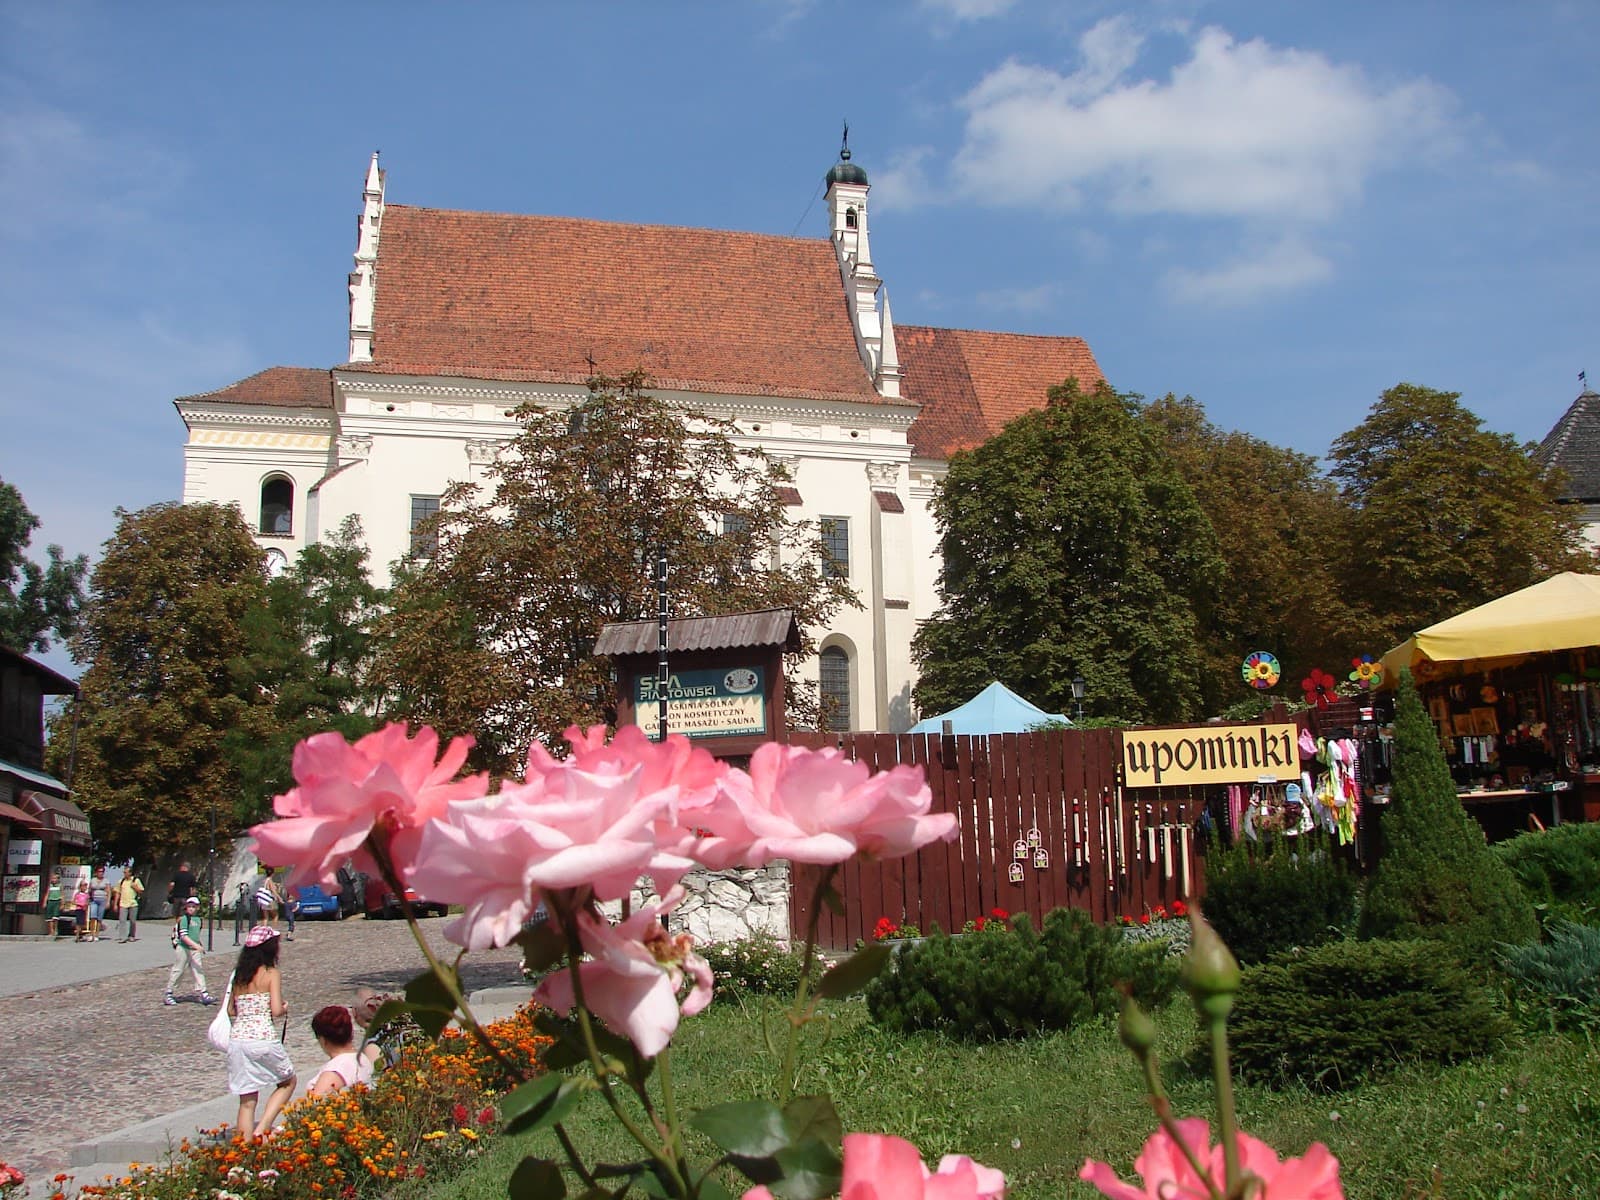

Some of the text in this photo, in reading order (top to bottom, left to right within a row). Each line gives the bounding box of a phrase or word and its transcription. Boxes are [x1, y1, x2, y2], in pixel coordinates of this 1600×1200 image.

[640, 686, 716, 700] PIATOWSKI
[667, 699, 734, 711] ASKINIA SOLNA
[653, 708, 745, 721] SON KOSMETYCZNY
[727, 716, 756, 726] SAUNA
[1126, 728, 1293, 783] upominki
